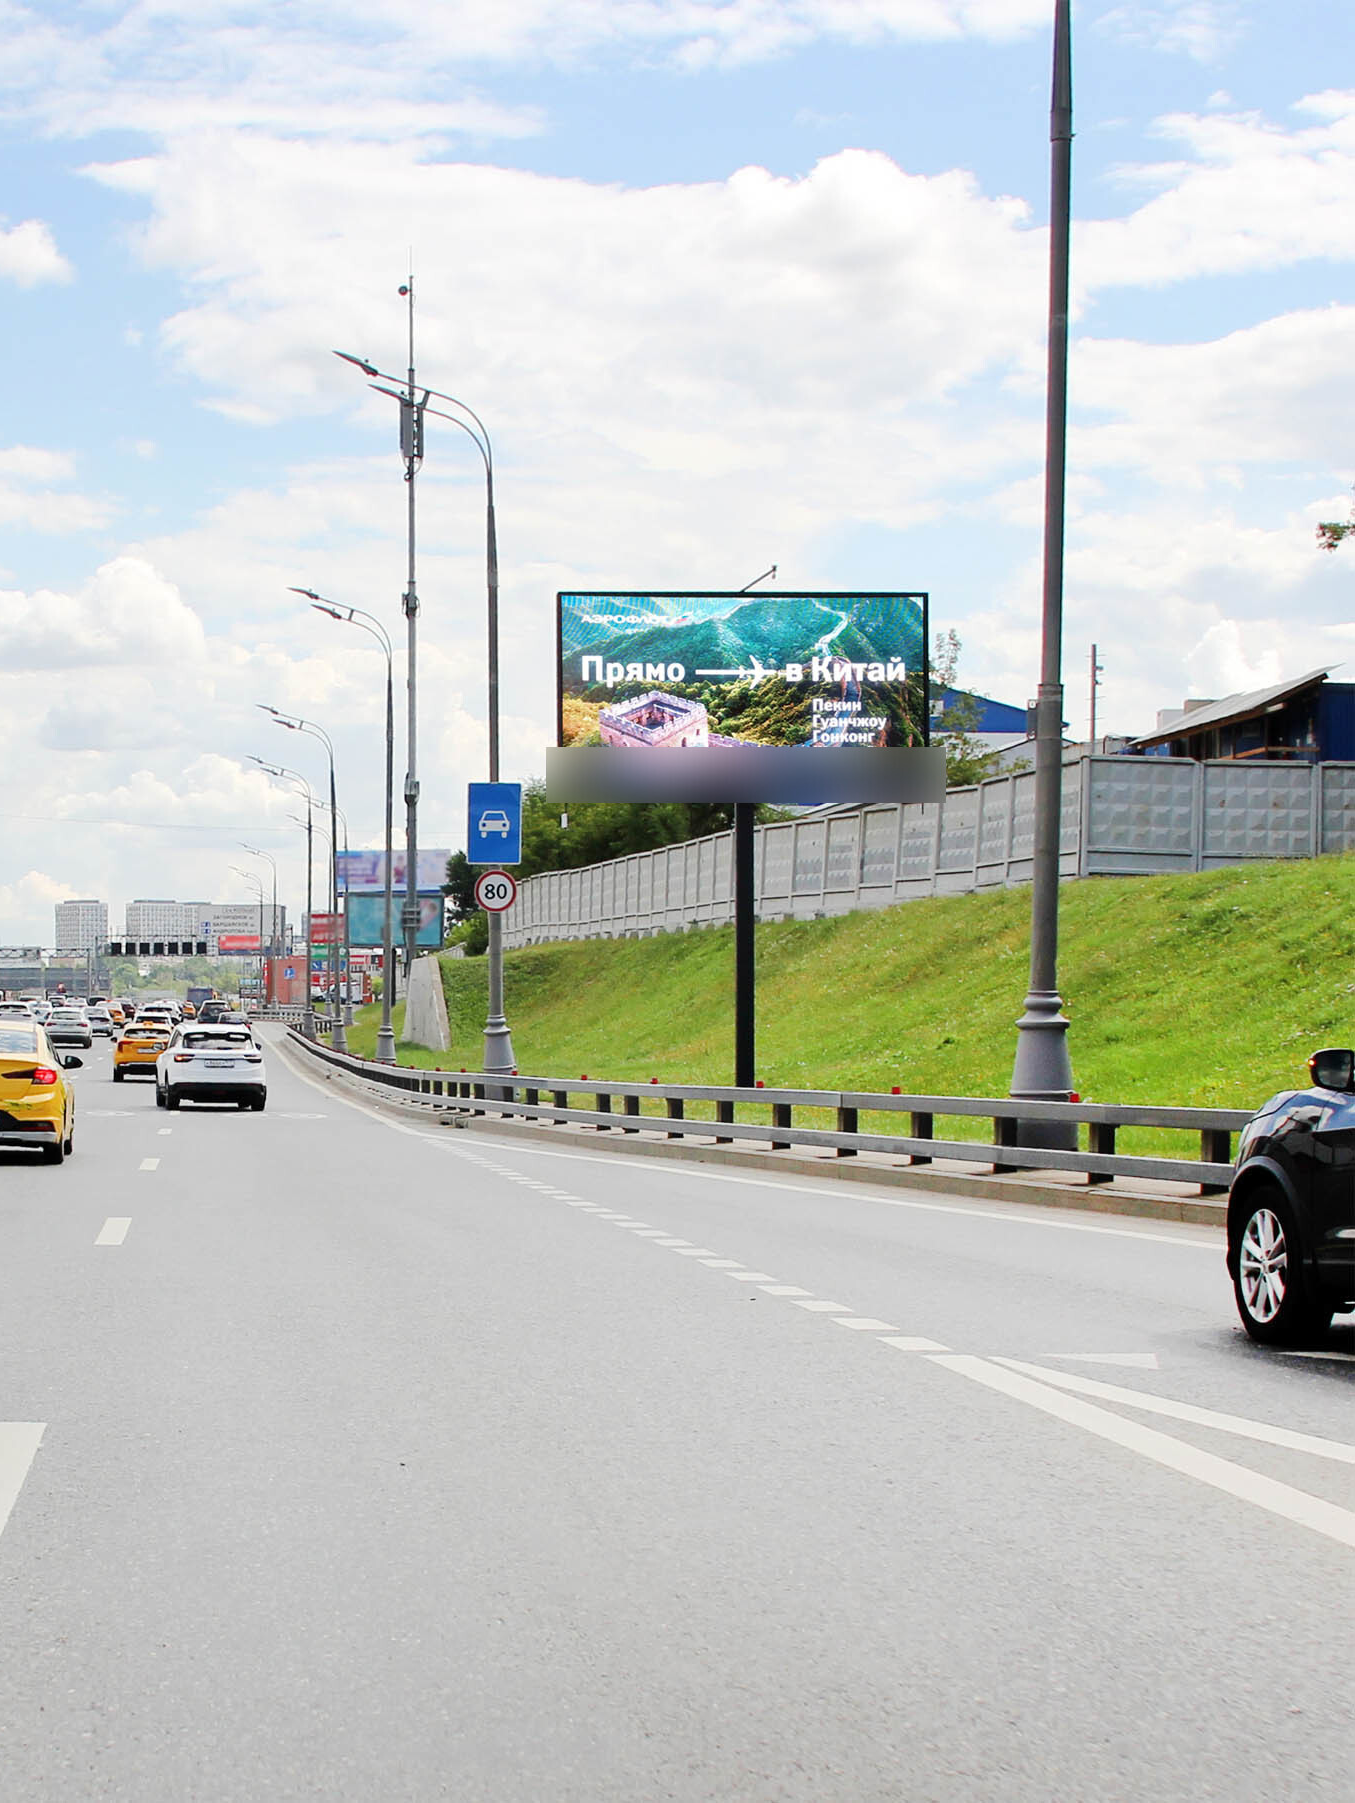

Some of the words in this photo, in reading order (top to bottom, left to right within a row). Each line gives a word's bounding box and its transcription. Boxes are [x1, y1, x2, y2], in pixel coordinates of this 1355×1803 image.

[581, 655, 686, 688] Прямо
[785, 663, 802, 682] в
[811, 656, 906, 682] Китай
[812, 698, 862, 712] Пекин
[812, 714, 887, 730] Гуанчжоу
[812, 729, 876, 743] Гонконг
[484, 883, 508, 900] 80
